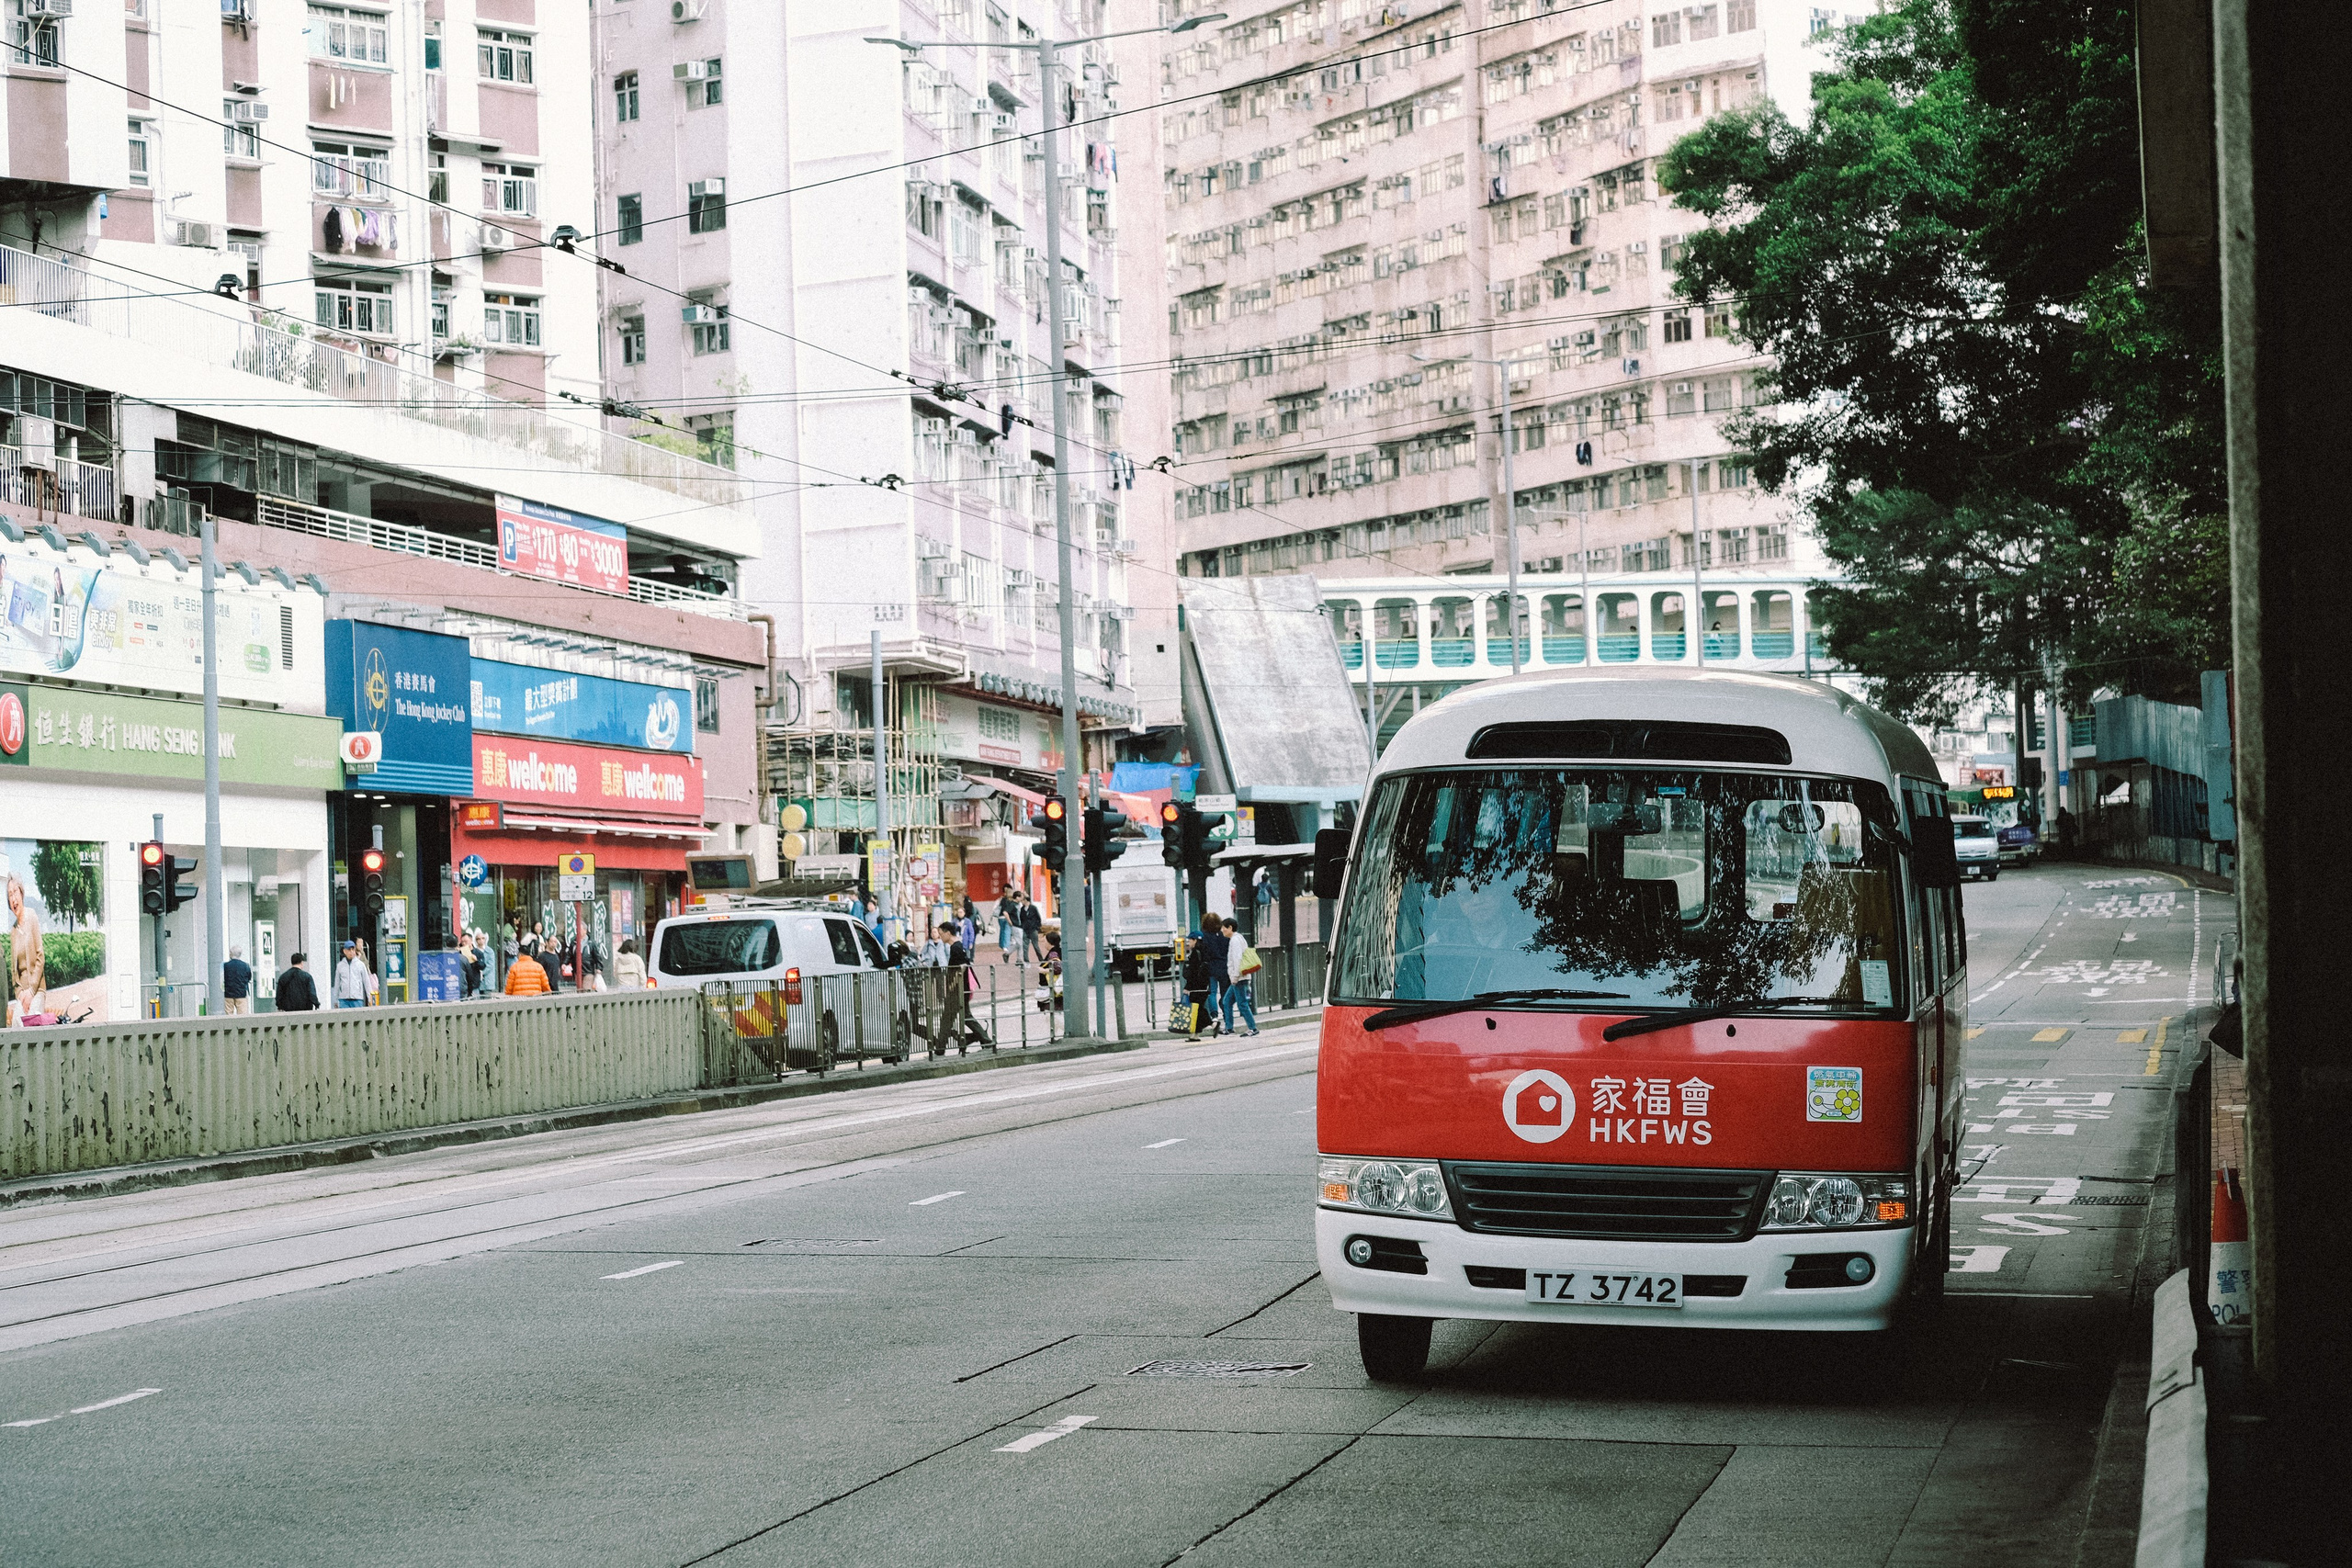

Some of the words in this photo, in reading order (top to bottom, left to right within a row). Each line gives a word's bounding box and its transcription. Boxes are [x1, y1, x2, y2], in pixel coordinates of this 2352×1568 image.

[504, 526, 514, 555] P
[533, 525, 557, 562] $170
[559, 533, 579, 568] $80
[590, 540, 623, 578] $3000
[89, 609, 117, 634] 更非常
[395, 671, 435, 694] 香港賽馬會
[395, 698, 406, 716] The
[406, 699, 421, 722] Hong
[421, 701, 435, 724] Kong
[435, 703, 452, 726] Jockey
[453, 705, 466, 723] Club
[122, 722, 161, 753] HANG
[164, 726, 198, 756] SENG
[481, 748, 507, 788] 惠康
[507, 751, 577, 794] wellcome
[600, 760, 624, 797] 惠康
[624, 763, 685, 802] wellcome
[465, 818, 494, 827] wellcome
[469, 806, 490, 819] 惠康
[582, 876, 587, 885] 7
[582, 891, 593, 899] 12
[264, 932, 271, 953] 24
[1590, 1075, 1715, 1116] 家福會
[1589, 1117, 1713, 1145] HKFWS
[1533, 1272, 1575, 1299] TZ
[1590, 1275, 1677, 1303] 3742
